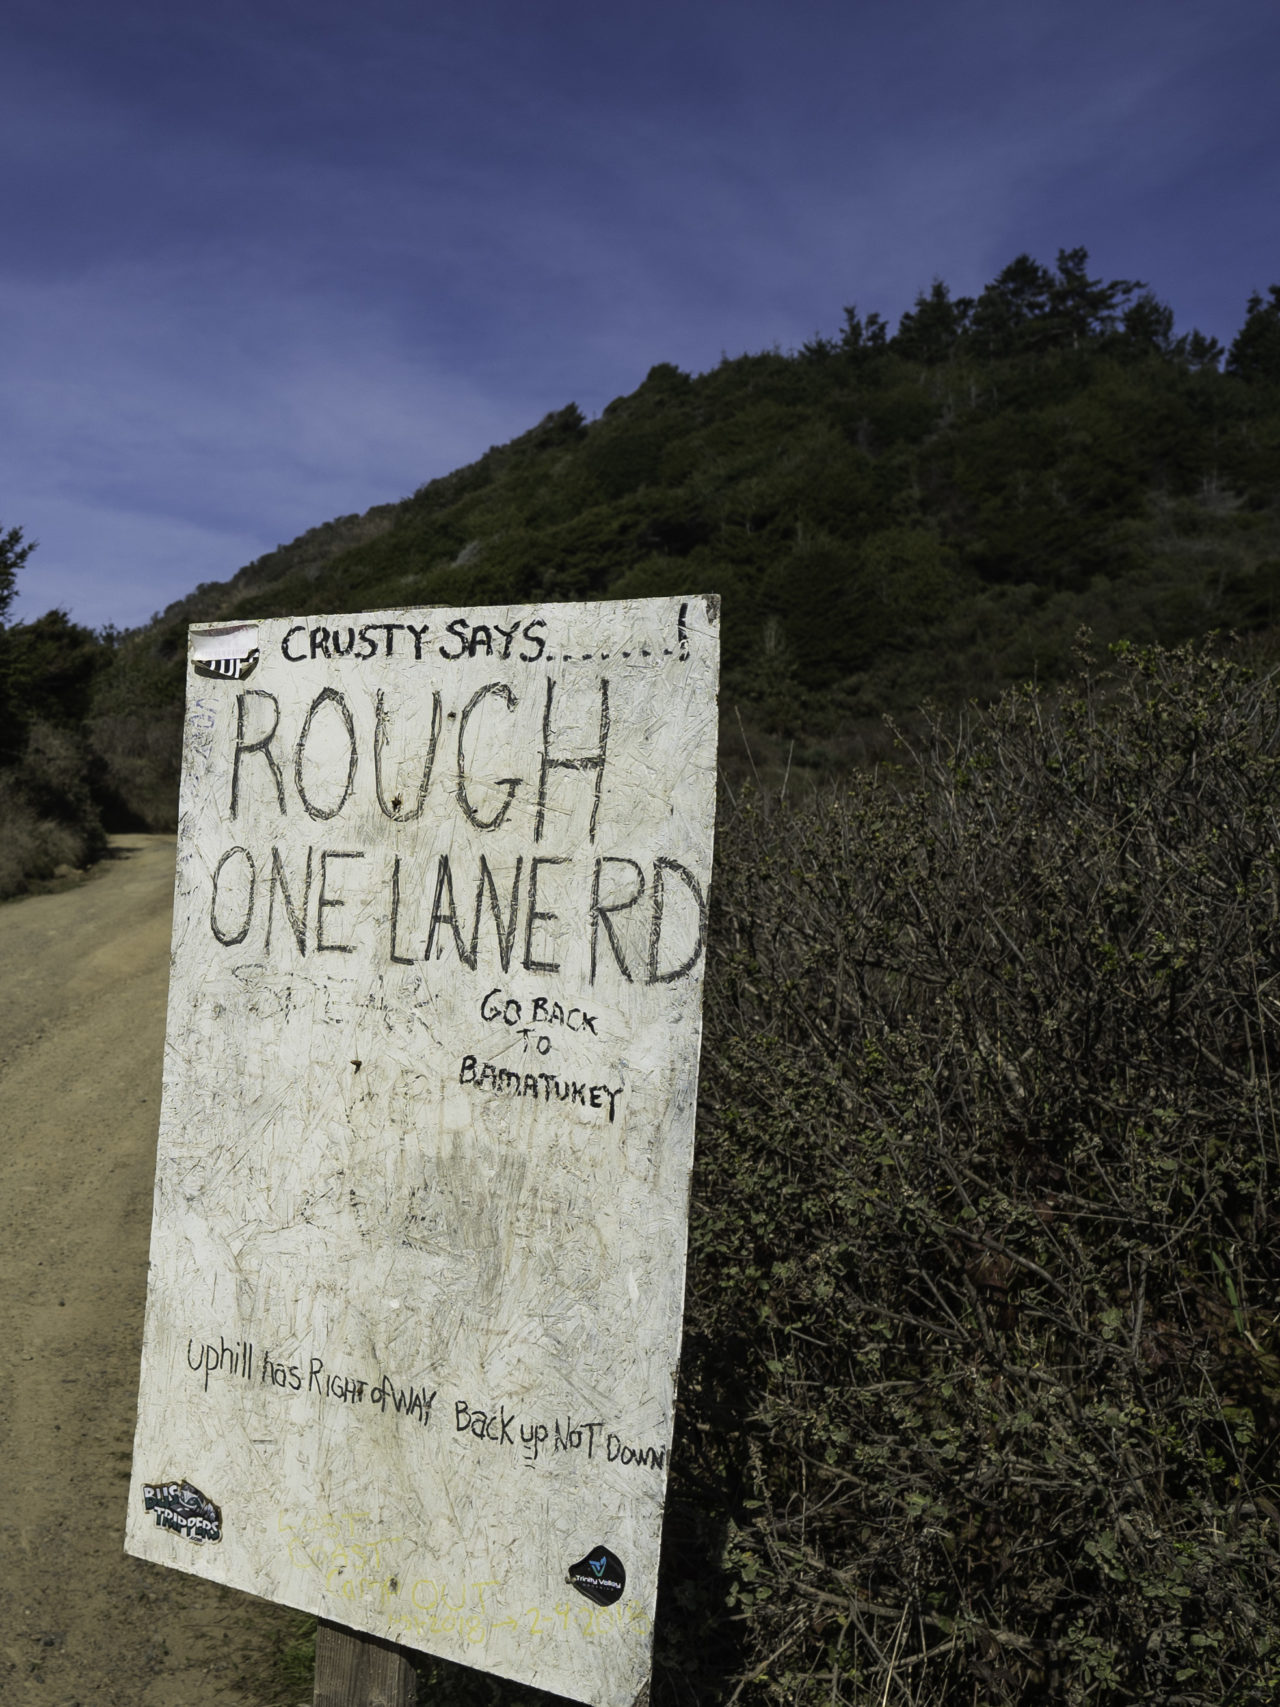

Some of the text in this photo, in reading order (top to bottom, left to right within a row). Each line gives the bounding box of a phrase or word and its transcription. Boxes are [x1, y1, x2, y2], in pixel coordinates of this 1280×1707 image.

[281, 623, 430, 662] CRUSTY
[229, 676, 611, 844] ROUGH
[209, 845, 708, 986] ONE LANE RD
[480, 988, 522, 1026] GO
[532, 996, 599, 1036] BACK
[516, 1028, 553, 1055] TO
[187, 1336, 253, 1392] Uphill
[261, 1350, 302, 1390] has
[308, 1357, 369, 1404] RIGHT
[392, 1385, 437, 1426] WAY
[455, 1400, 515, 1445] Back
[520, 1423, 549, 1460] up
[143, 1484, 180, 1510] BUS
[153, 1505, 221, 1541] TRIPPERS
[277, 1510, 370, 1538] LOST
[288, 1537, 402, 1569] COAST
[411, 1578, 501, 1615] OUT
[575, 1574, 598, 1585] Trinity
[598, 1578, 622, 1589] Valley
